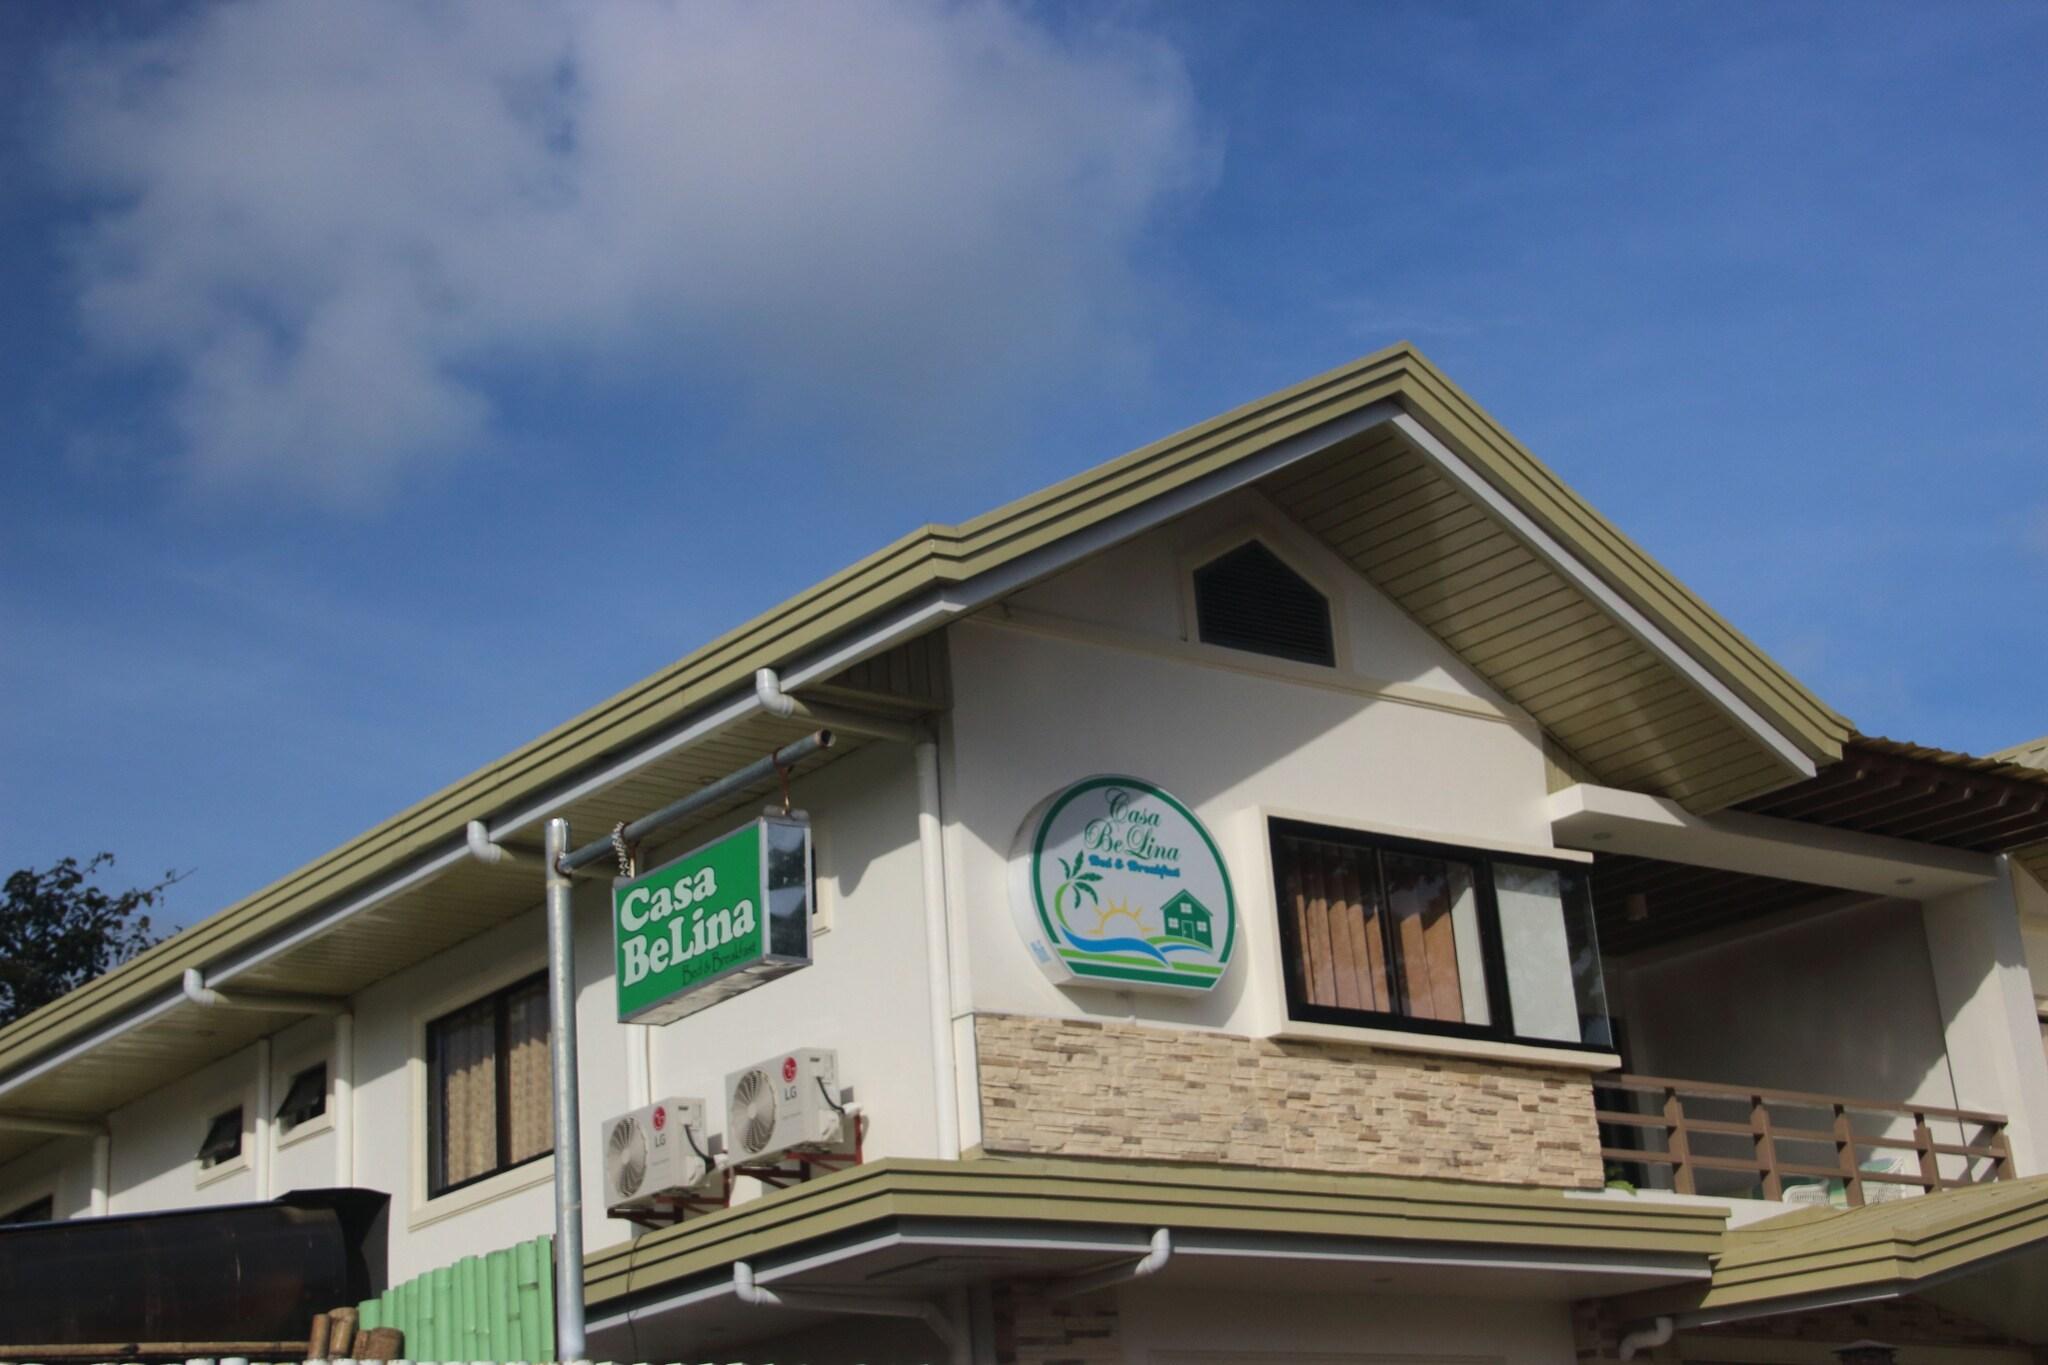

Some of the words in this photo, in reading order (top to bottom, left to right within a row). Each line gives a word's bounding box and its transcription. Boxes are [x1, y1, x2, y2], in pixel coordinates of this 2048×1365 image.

[1106, 788, 1160, 825] Casa
[620, 867, 717, 931] Casa
[622, 899, 756, 987] BeLina
[784, 1086, 797, 1101] LG
[655, 1134, 667, 1148] LG
